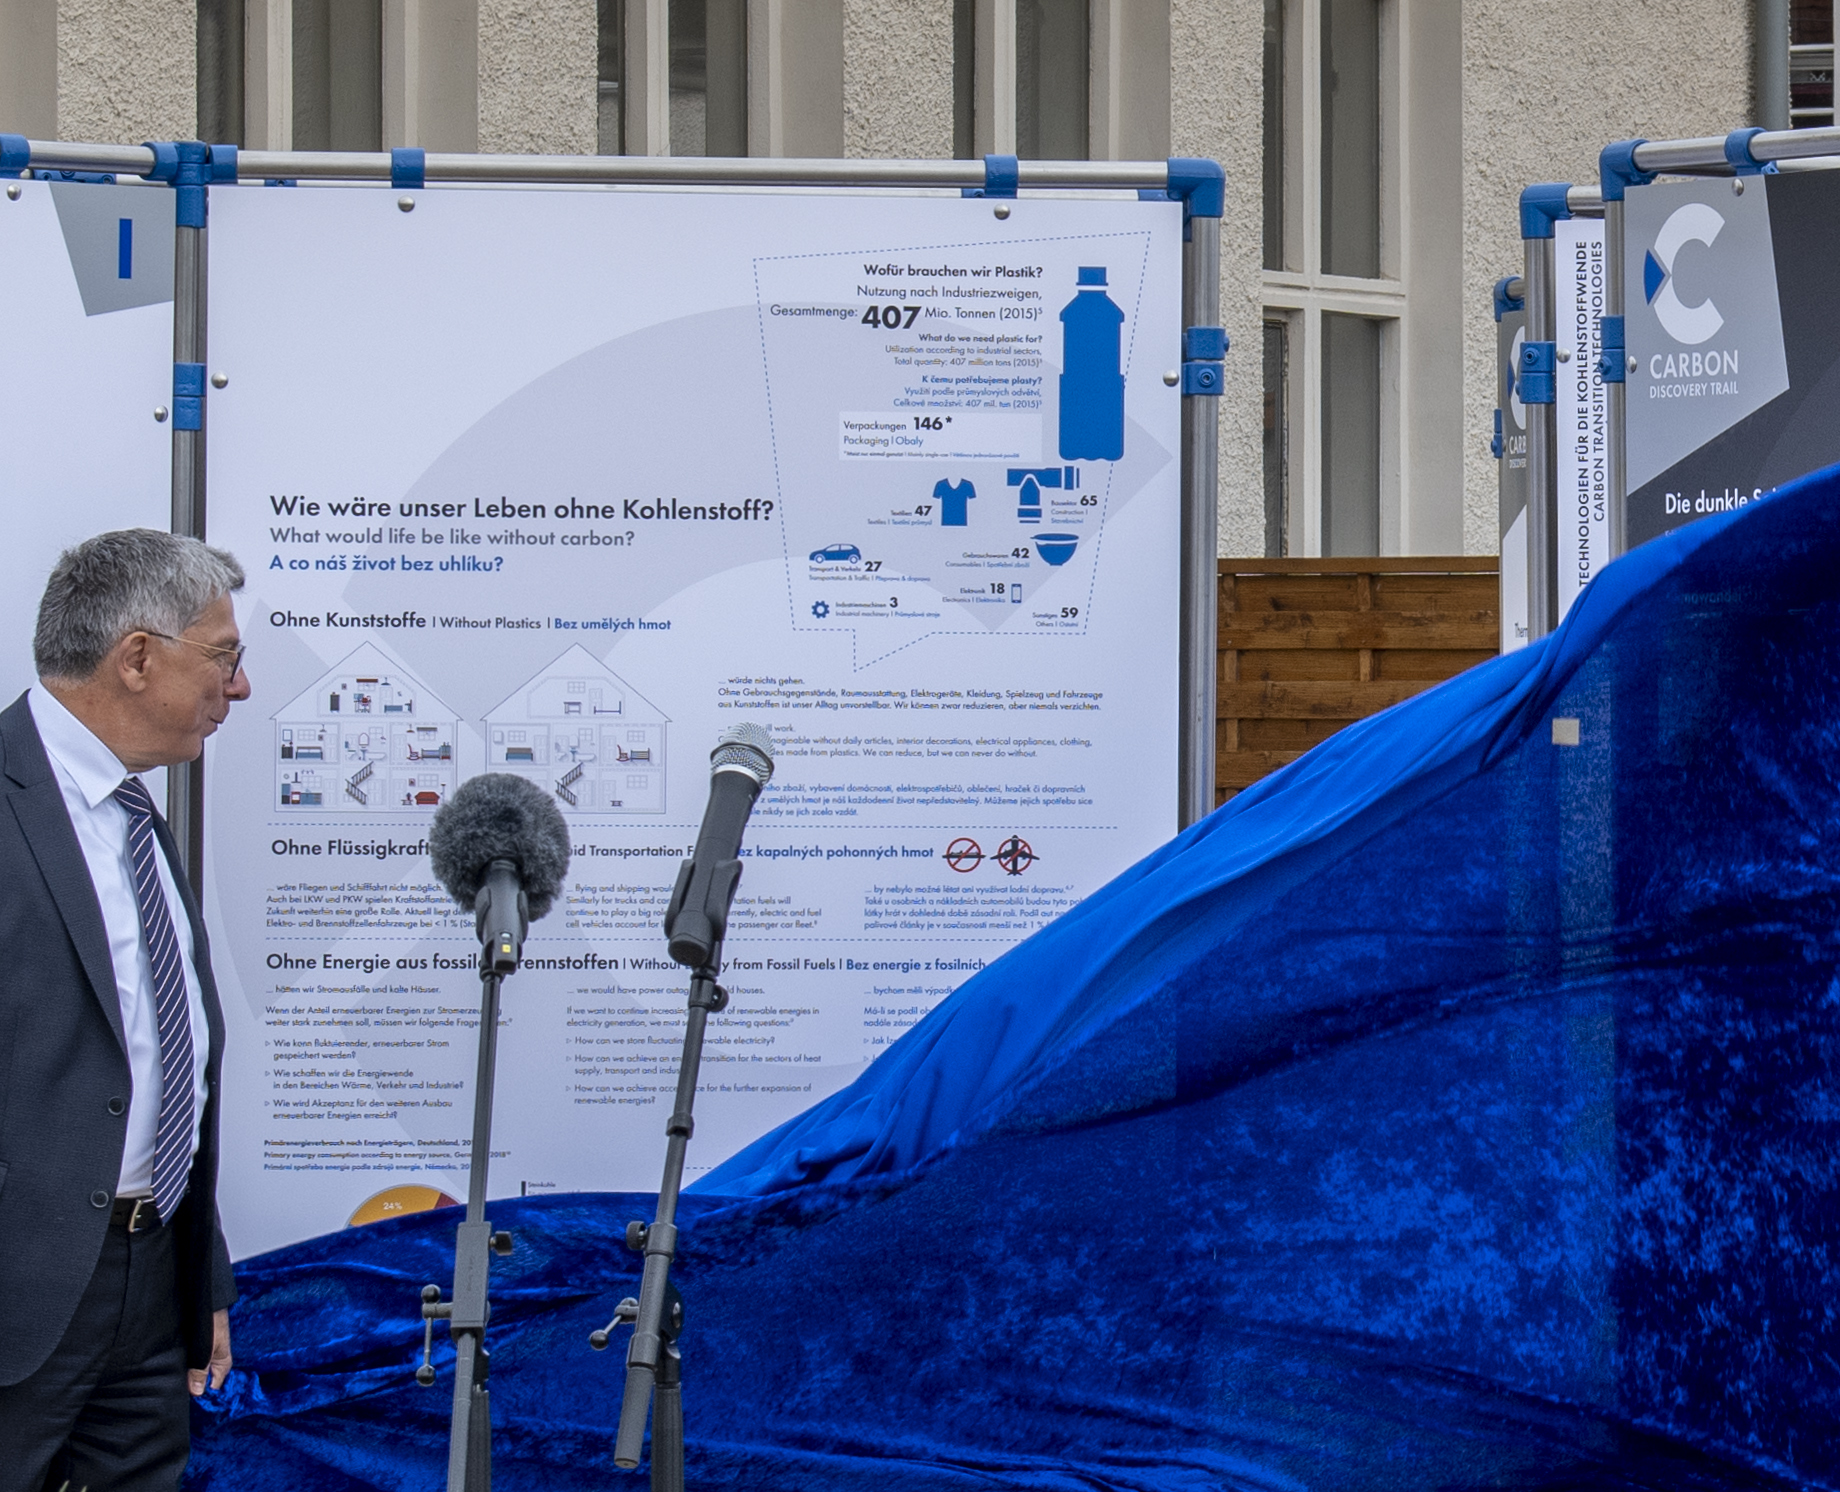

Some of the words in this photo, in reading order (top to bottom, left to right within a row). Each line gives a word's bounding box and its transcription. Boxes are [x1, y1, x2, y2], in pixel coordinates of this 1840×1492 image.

[118, 218, 134, 279] I
[863, 263, 905, 277] Wofür
[907, 264, 968, 277] brauchen
[970, 265, 992, 278] wir
[995, 265, 1044, 279] Plastik?
[769, 303, 860, 321] Gesamtmenge:
[861, 305, 922, 330] 407
[924, 306, 951, 319] Mio.
[954, 306, 996, 319] Tonnen
[1575, 240, 1589, 403] KOHLENSTOFFWENDE
[1649, 349, 1739, 379] CARBON
[1649, 382, 1708, 399] DISCOVERY
[1710, 380, 1739, 396] TRAIL
[843, 420, 907, 433] Verpackungen
[1576, 407, 1589, 430] DIE
[1574, 431, 1590, 463] FÜR
[1593, 457, 1606, 523] CARBON
[269, 495, 321, 517] Wie
[327, 496, 392, 517] wäre
[399, 503, 467, 518] unser
[474, 496, 546, 519] Leben
[554, 496, 615, 520] ohne
[623, 497, 774, 521] Kohlenstoff?
[1080, 495, 1098, 507] 65
[1665, 492, 1691, 514] Die
[914, 505, 933, 517] 47
[269, 526, 321, 544] What
[325, 527, 383, 544] would
[388, 527, 416, 545] life
[421, 527, 445, 545] be
[450, 527, 482, 545] like
[486, 528, 556, 546] without
[560, 529, 635, 547] carbon?
[1577, 467, 1591, 588] TECHNOLOGIEN
[1011, 547, 1030, 559] 42
[269, 554, 284, 570] A
[288, 559, 310, 571] co
[315, 554, 347, 571] náš
[352, 554, 397, 571] život
[401, 554, 434, 572] bez
[439, 554, 504, 572] uhlíku?
[864, 560, 883, 572] 27
[990, 582, 1005, 595] 18
[889, 596, 899, 609] 3
[269, 610, 321, 628] Ohne
[326, 611, 427, 629] Kunststoffe
[1060, 607, 1079, 619] 59
[756, 844, 824, 861] kapalných
[826, 844, 899, 861] pohonných
[901, 845, 935, 858] hmot
[266, 952, 317, 970] Ohne
[322, 953, 391, 974] Energie
[395, 958, 428, 970] aus
